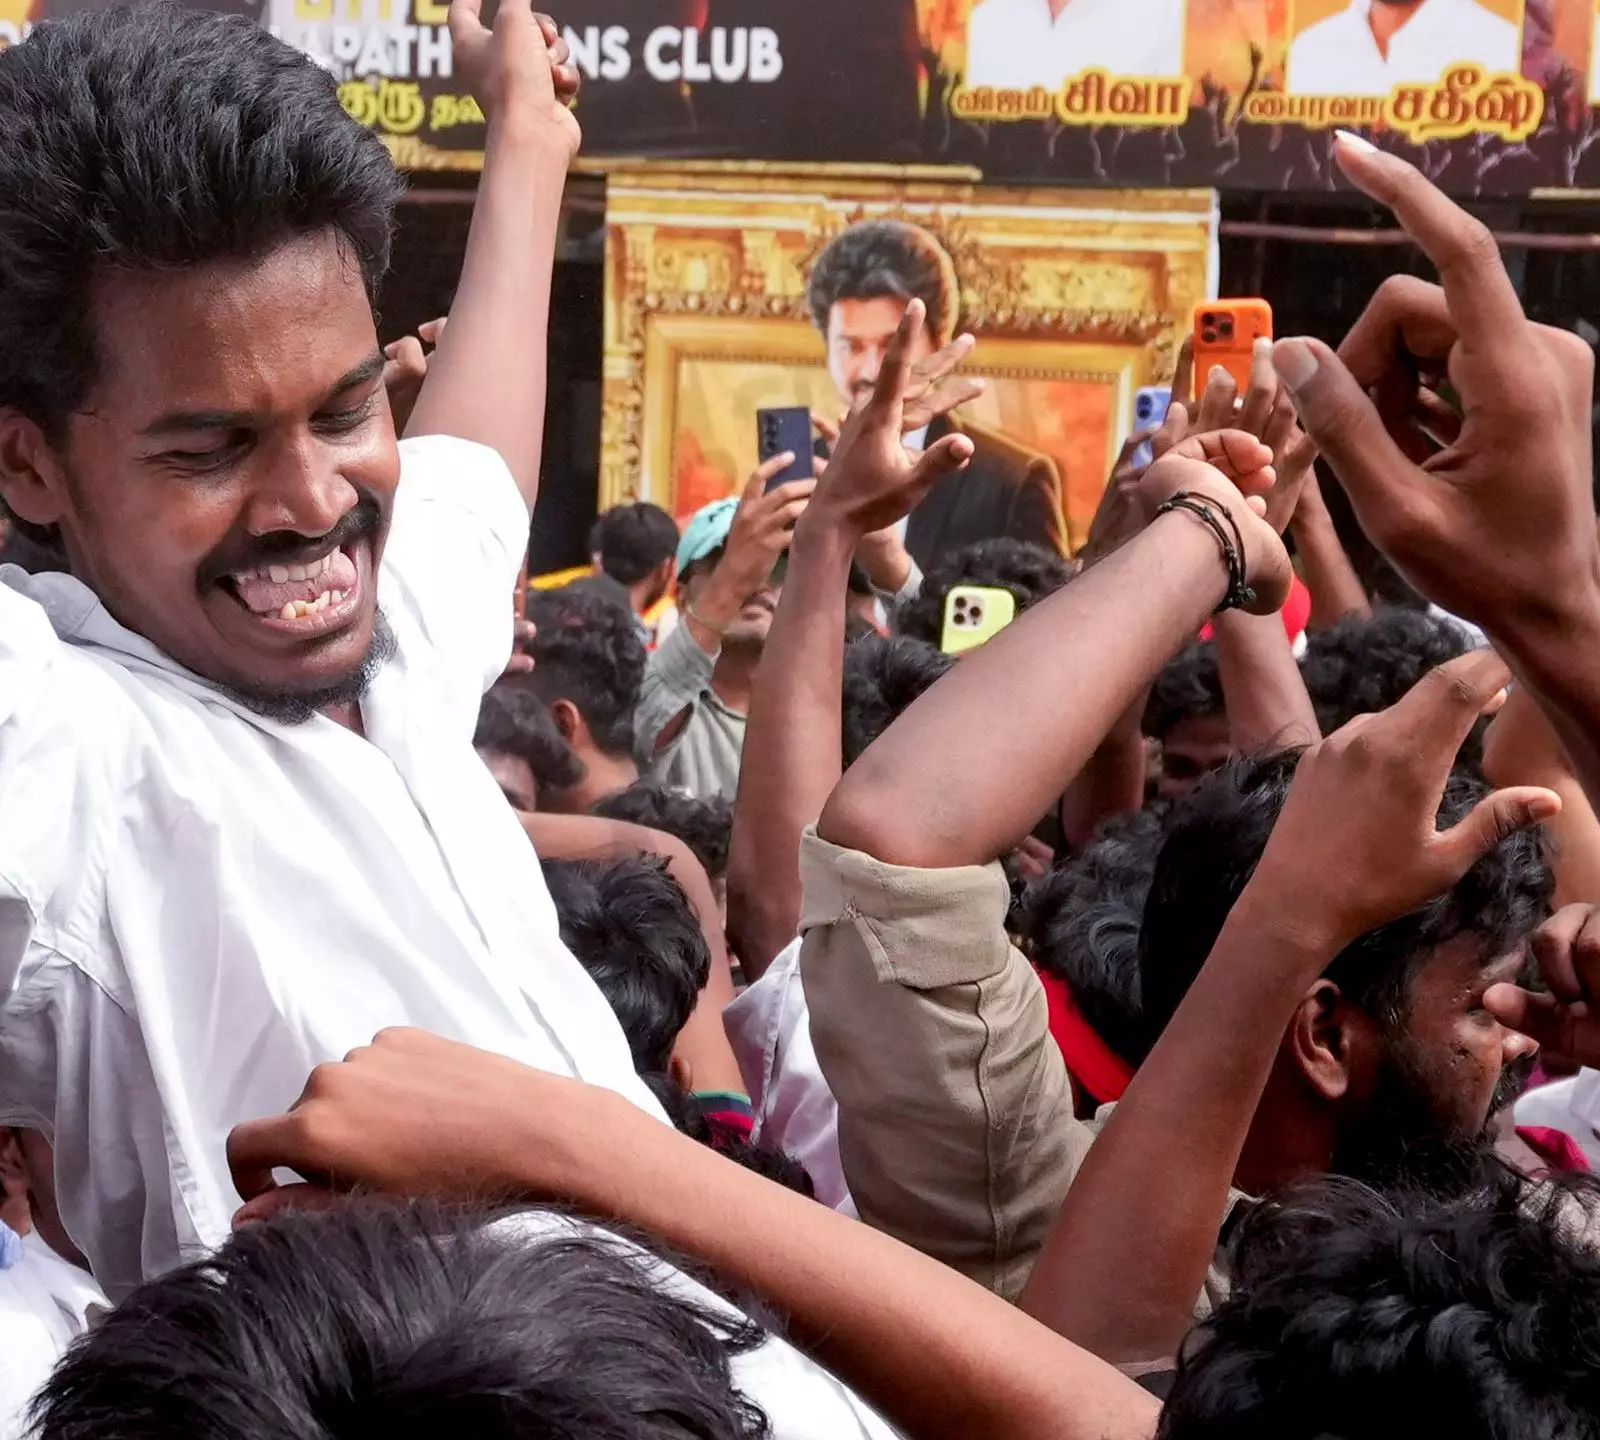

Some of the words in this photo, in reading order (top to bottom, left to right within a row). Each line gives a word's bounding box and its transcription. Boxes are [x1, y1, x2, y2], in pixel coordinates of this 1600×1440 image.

[642, 24, 784, 84] CLUB
[1061, 67, 1189, 121] சிவா
[1389, 62, 1541, 140] சதீஷ்
